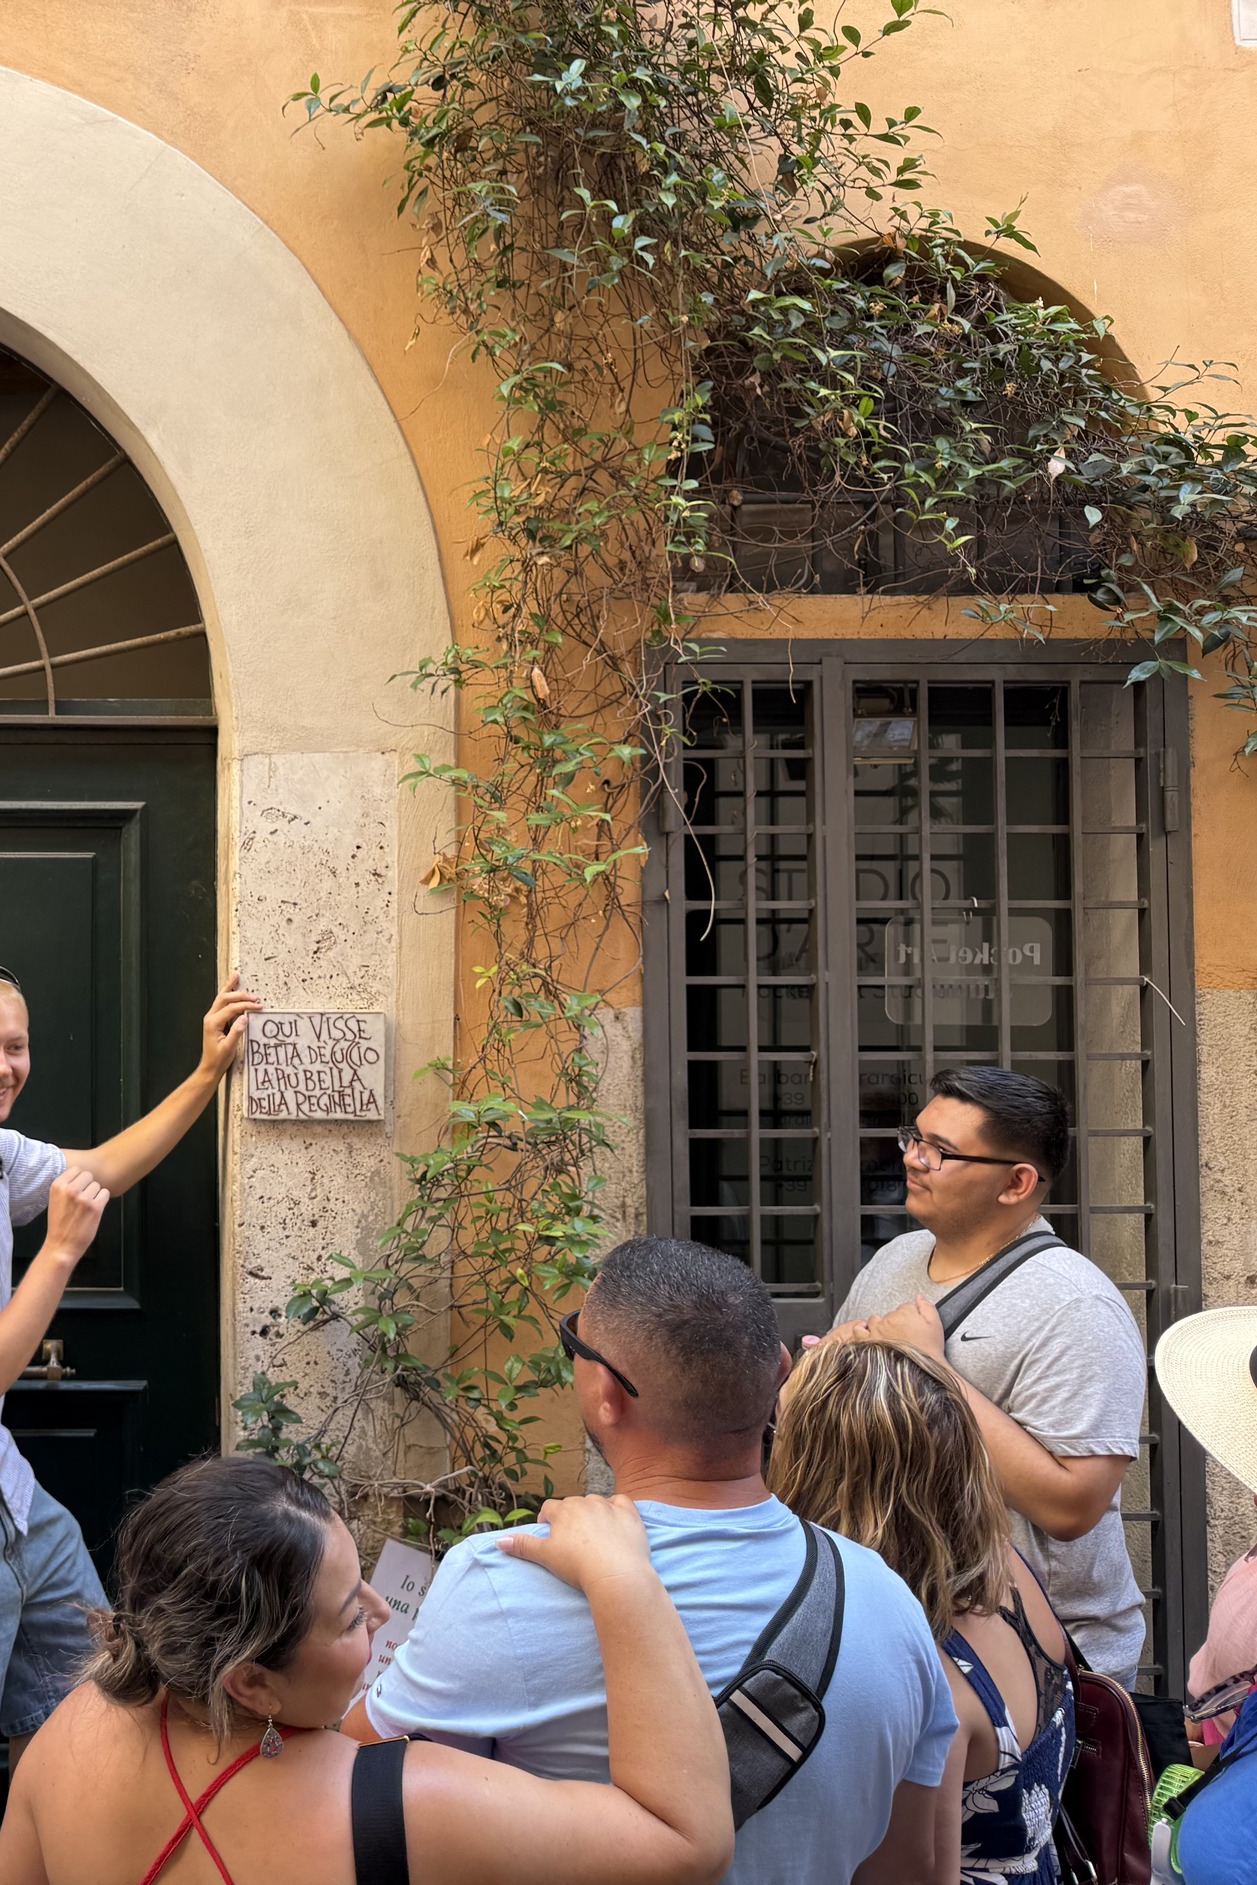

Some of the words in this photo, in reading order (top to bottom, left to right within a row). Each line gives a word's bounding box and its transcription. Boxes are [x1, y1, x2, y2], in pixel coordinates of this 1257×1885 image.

[308, 1013, 372, 1042] VISSE
[250, 1039, 303, 1067] BETTA
[254, 1067, 274, 1091] LA
[303, 1066, 367, 1093] BELLA
[249, 1091, 291, 1116] DELLA
[294, 1087, 381, 1118] REGINELLA
[385, 1595, 410, 1614] una
